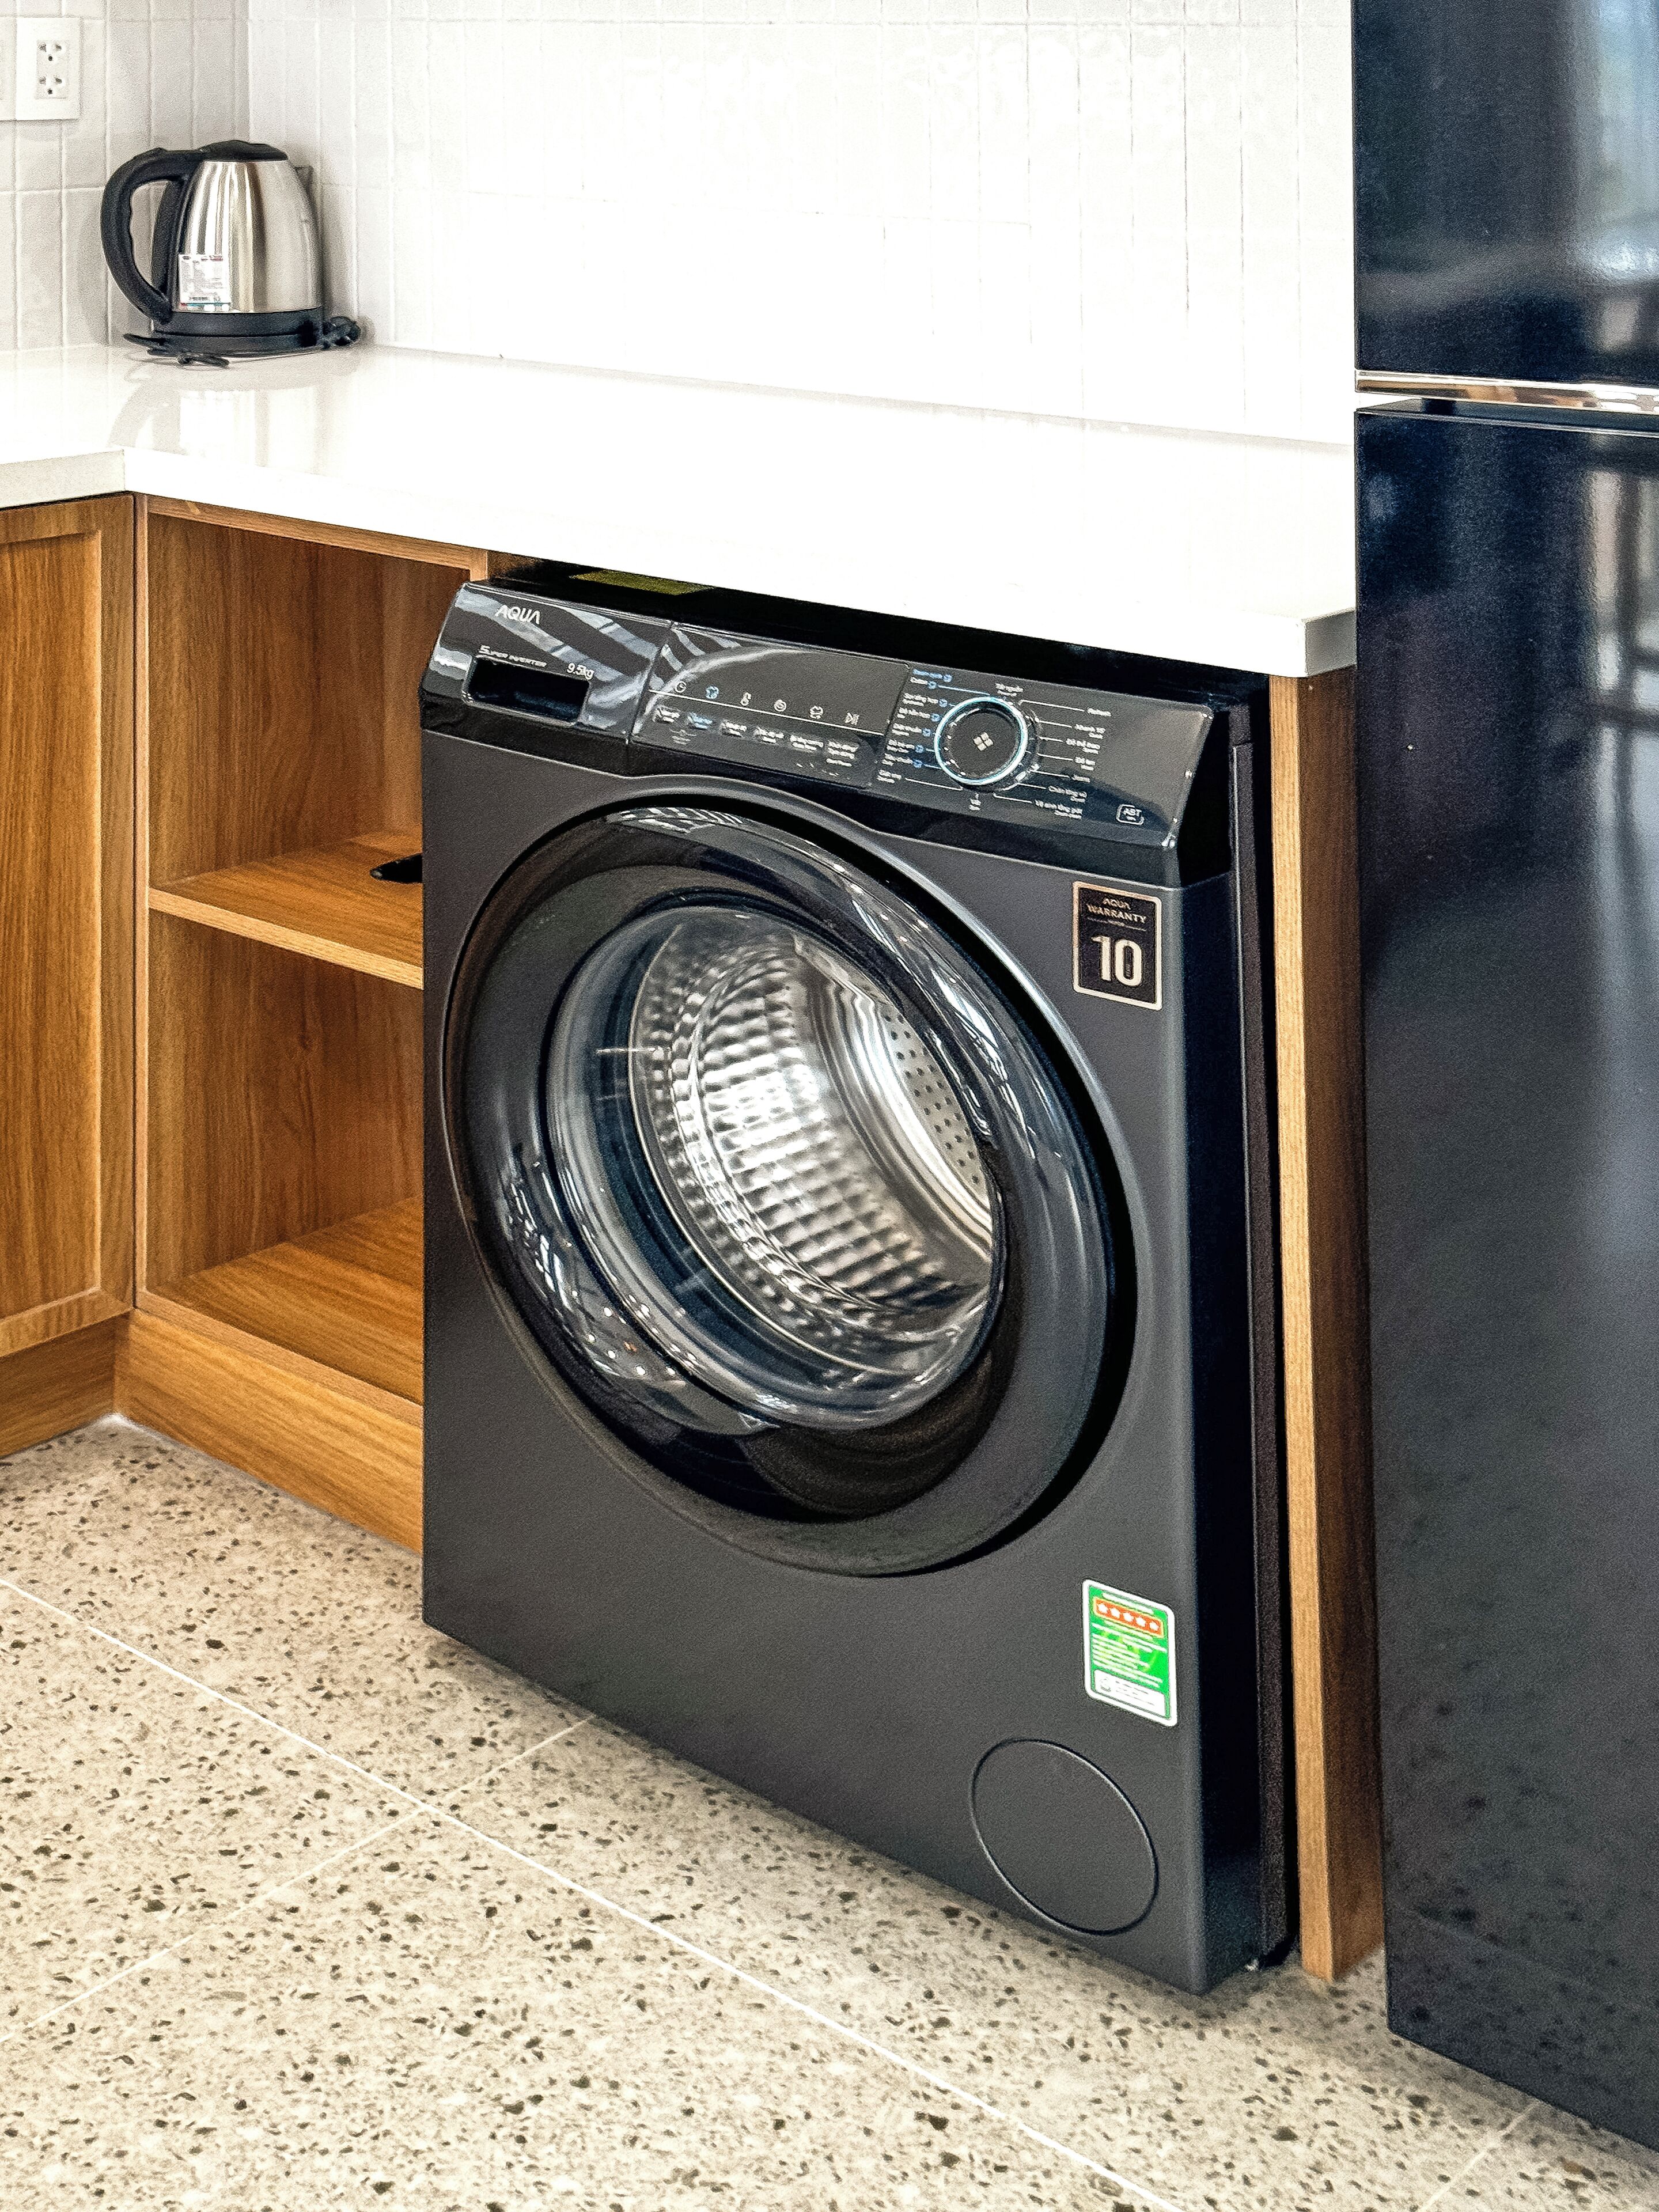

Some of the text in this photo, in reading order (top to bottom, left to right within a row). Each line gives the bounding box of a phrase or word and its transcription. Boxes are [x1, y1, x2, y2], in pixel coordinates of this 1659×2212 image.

[495, 605, 540, 624] AQUA
[567, 662, 595, 680] 9.5kg
[1086, 903, 1147, 923] WARRANTY
[1102, 897, 1131, 910] AQUA
[1090, 935, 1142, 987] 10
